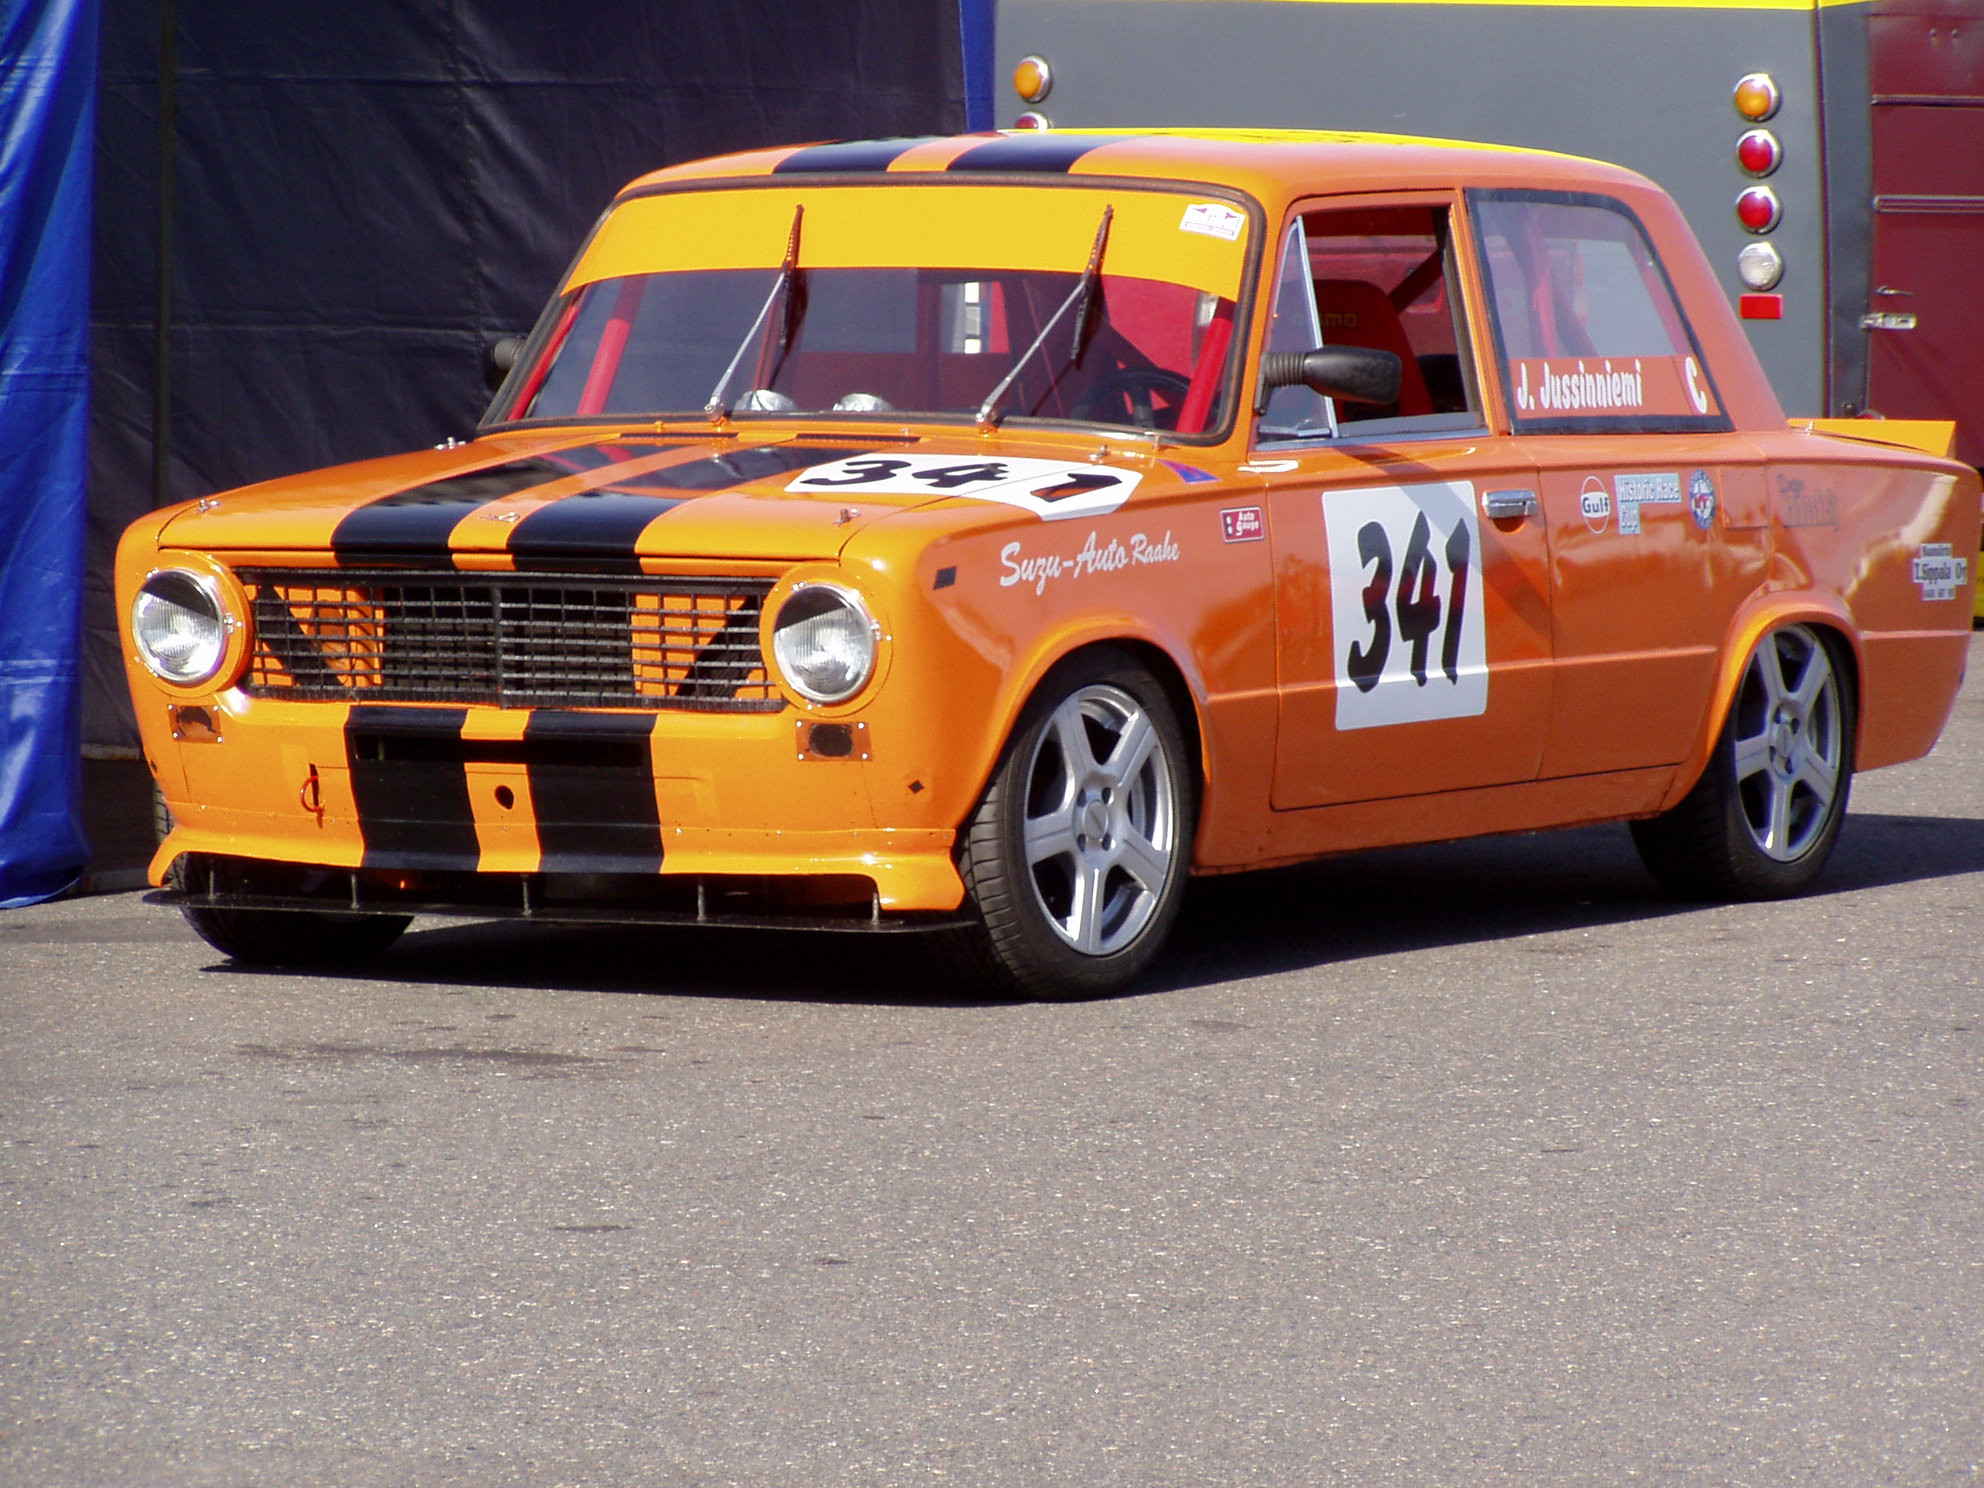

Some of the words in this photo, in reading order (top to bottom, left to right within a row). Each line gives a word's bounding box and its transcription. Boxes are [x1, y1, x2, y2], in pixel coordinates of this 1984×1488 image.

[1517, 362, 1535, 410] J.
[1540, 359, 1643, 409] Jussinniemi
[1582, 496, 1610, 514] Gulf
[1000, 530, 1128, 596] Suzu-Auto
[1130, 530, 1180, 566] Raahe
[1347, 510, 1471, 693] 341
